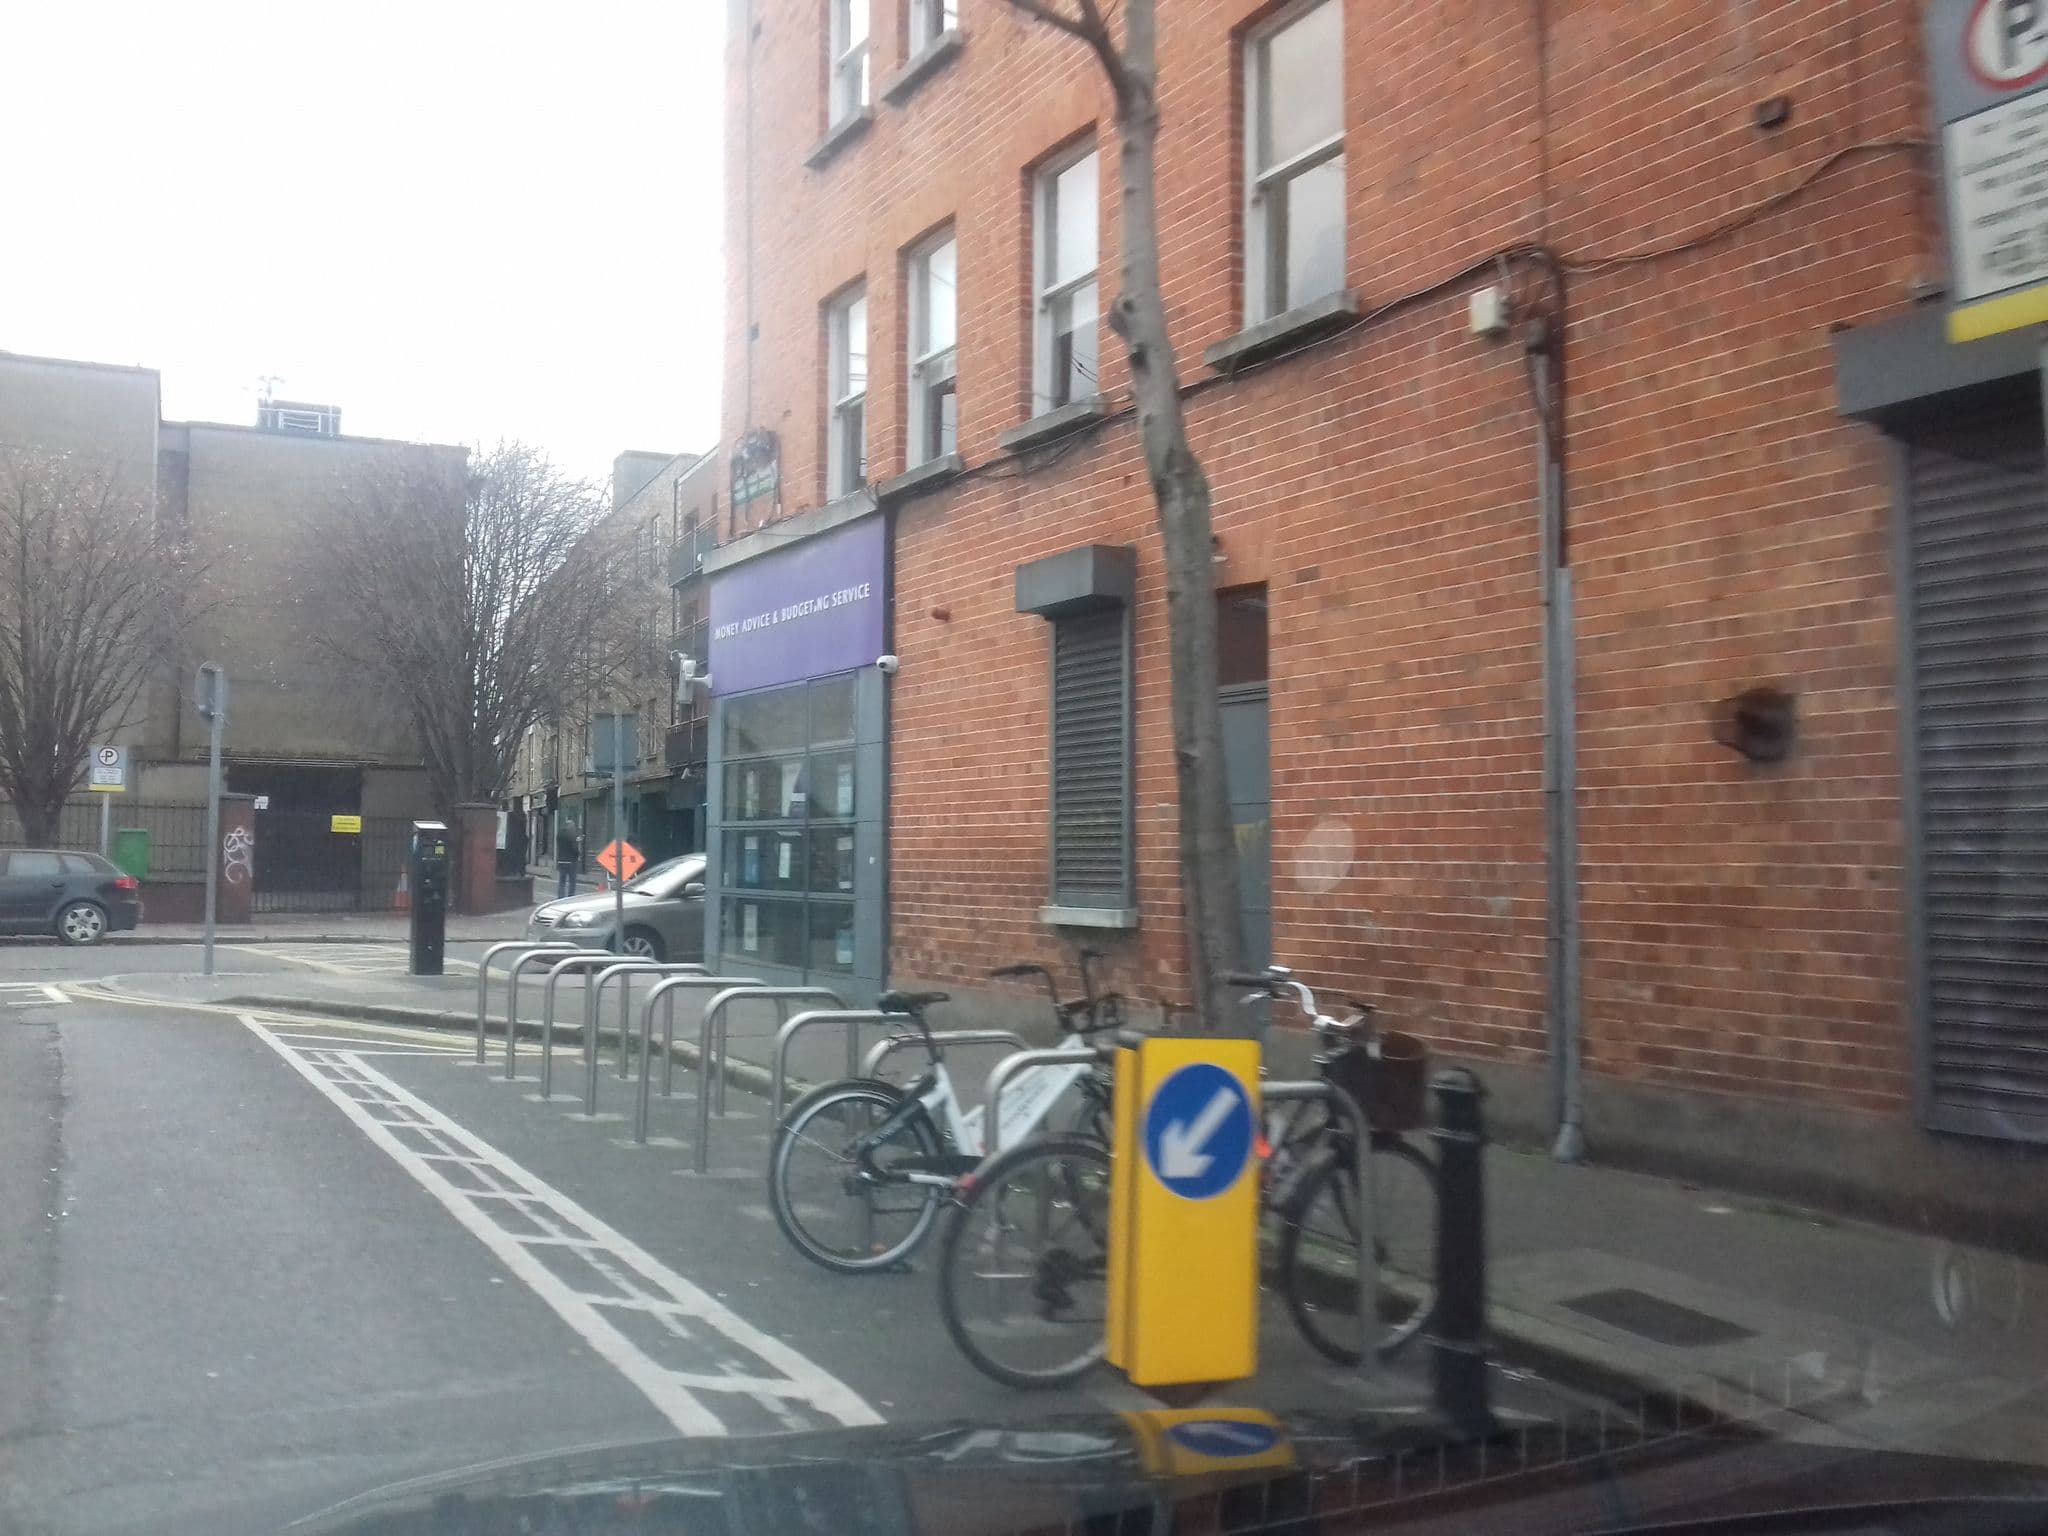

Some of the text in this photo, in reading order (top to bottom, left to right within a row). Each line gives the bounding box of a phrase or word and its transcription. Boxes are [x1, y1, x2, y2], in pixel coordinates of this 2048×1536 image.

[715, 621, 739, 640] MONEY
[742, 613, 770, 632] ADVICE
[773, 611, 778, 624] &
[831, 582, 870, 607] SERVICE
[105, 750, 114, 762] P
